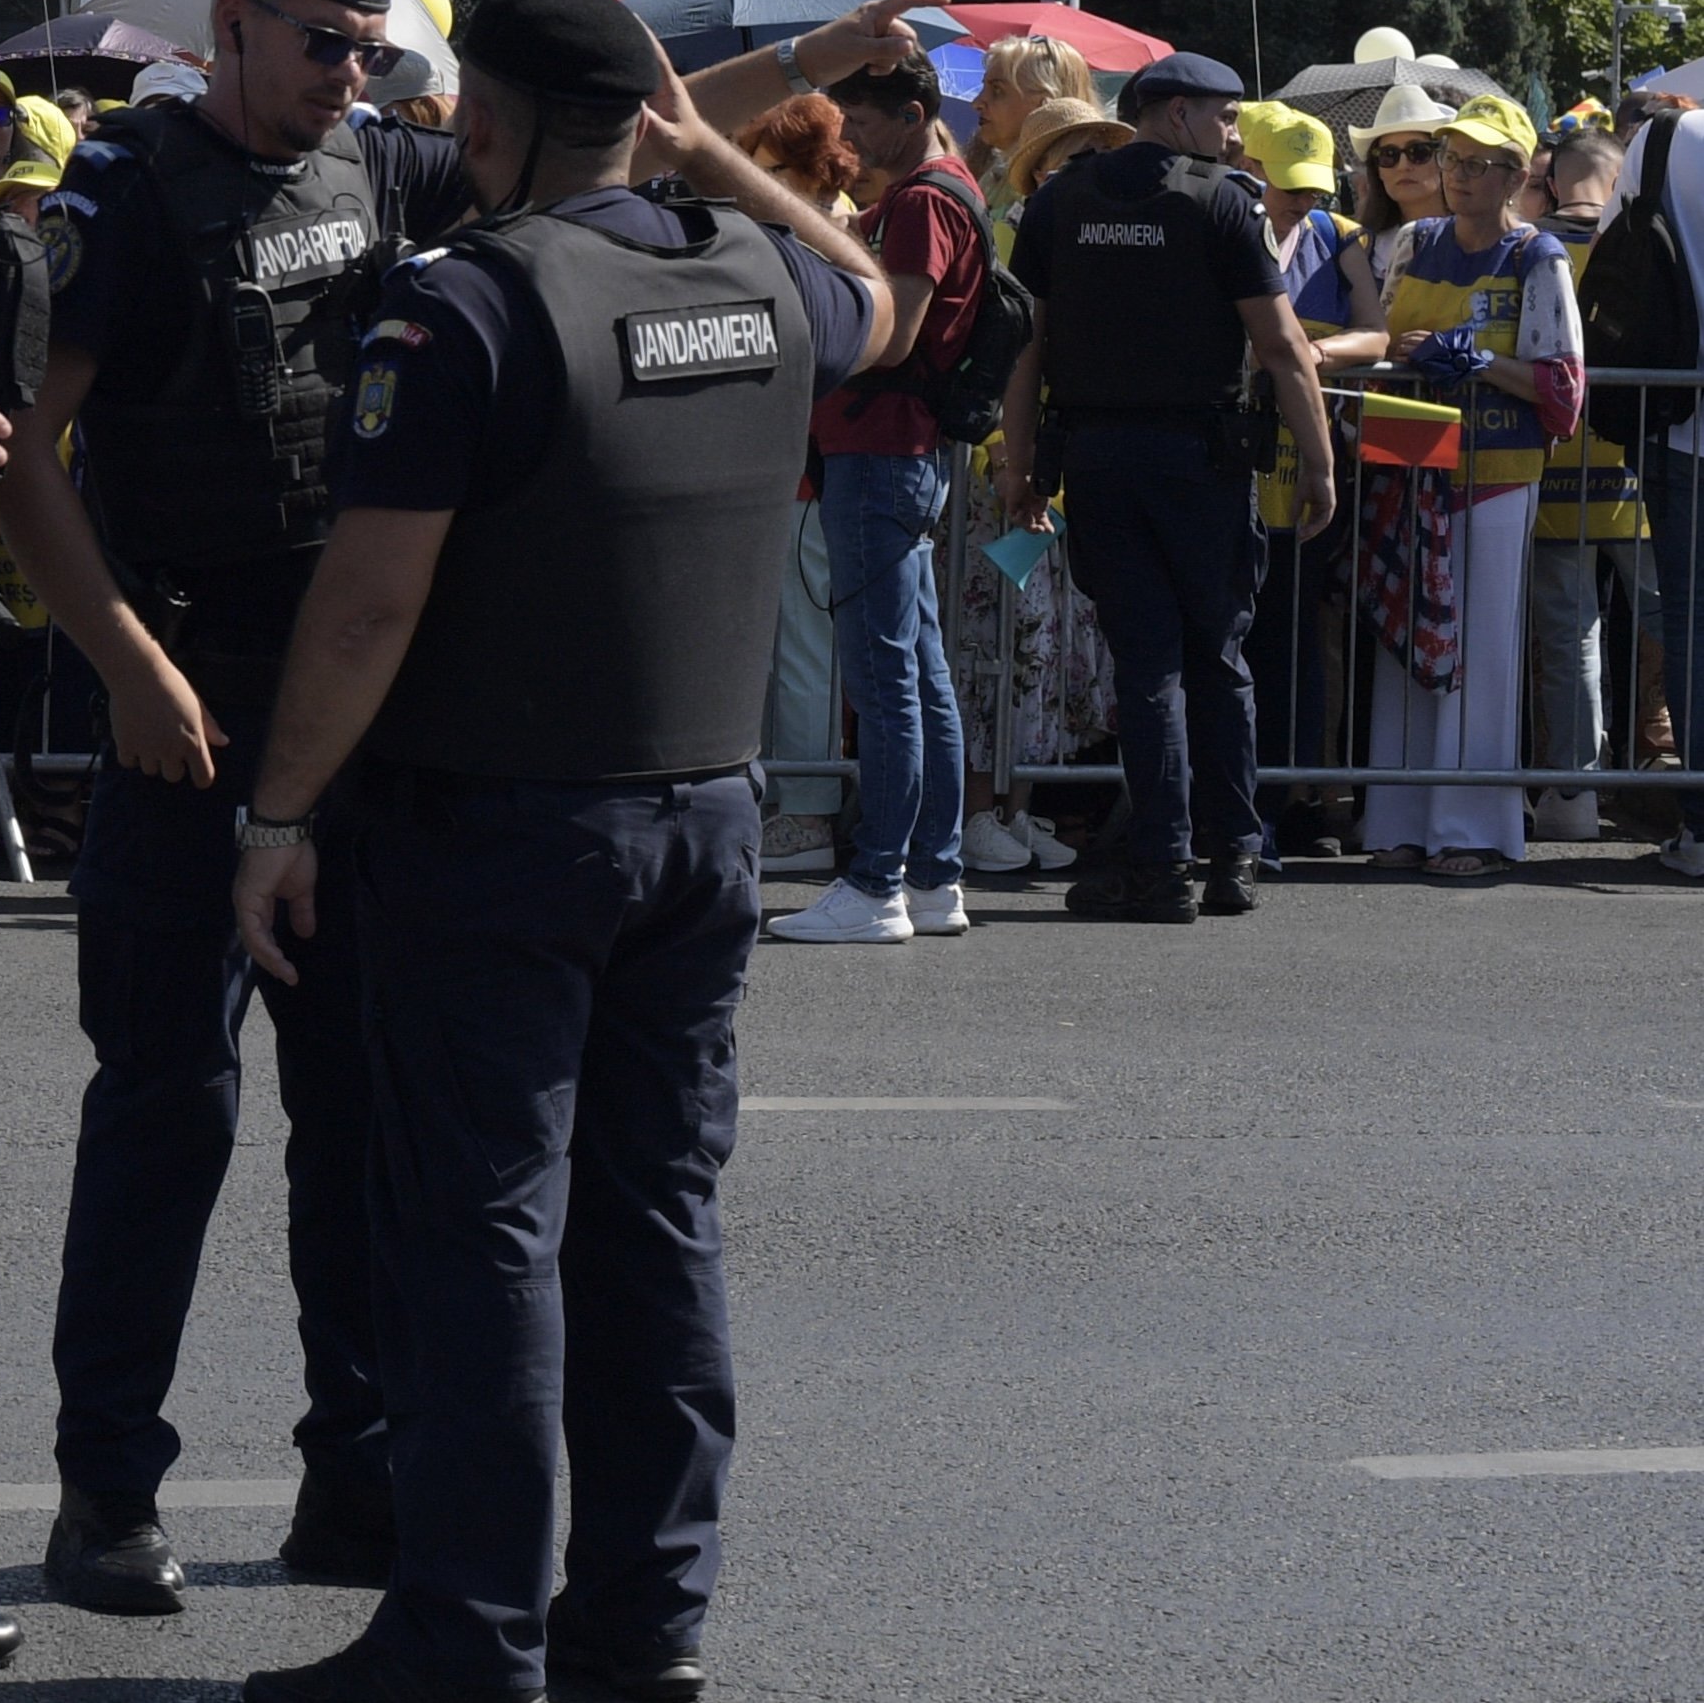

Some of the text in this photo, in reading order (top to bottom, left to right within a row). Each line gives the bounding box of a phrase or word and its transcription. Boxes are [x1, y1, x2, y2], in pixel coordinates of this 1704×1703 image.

[254, 218, 367, 280] ANDARMERIA
[1077, 223, 1166, 246] JANDARMERIA
[634, 311, 778, 369] JANDARMERIA
